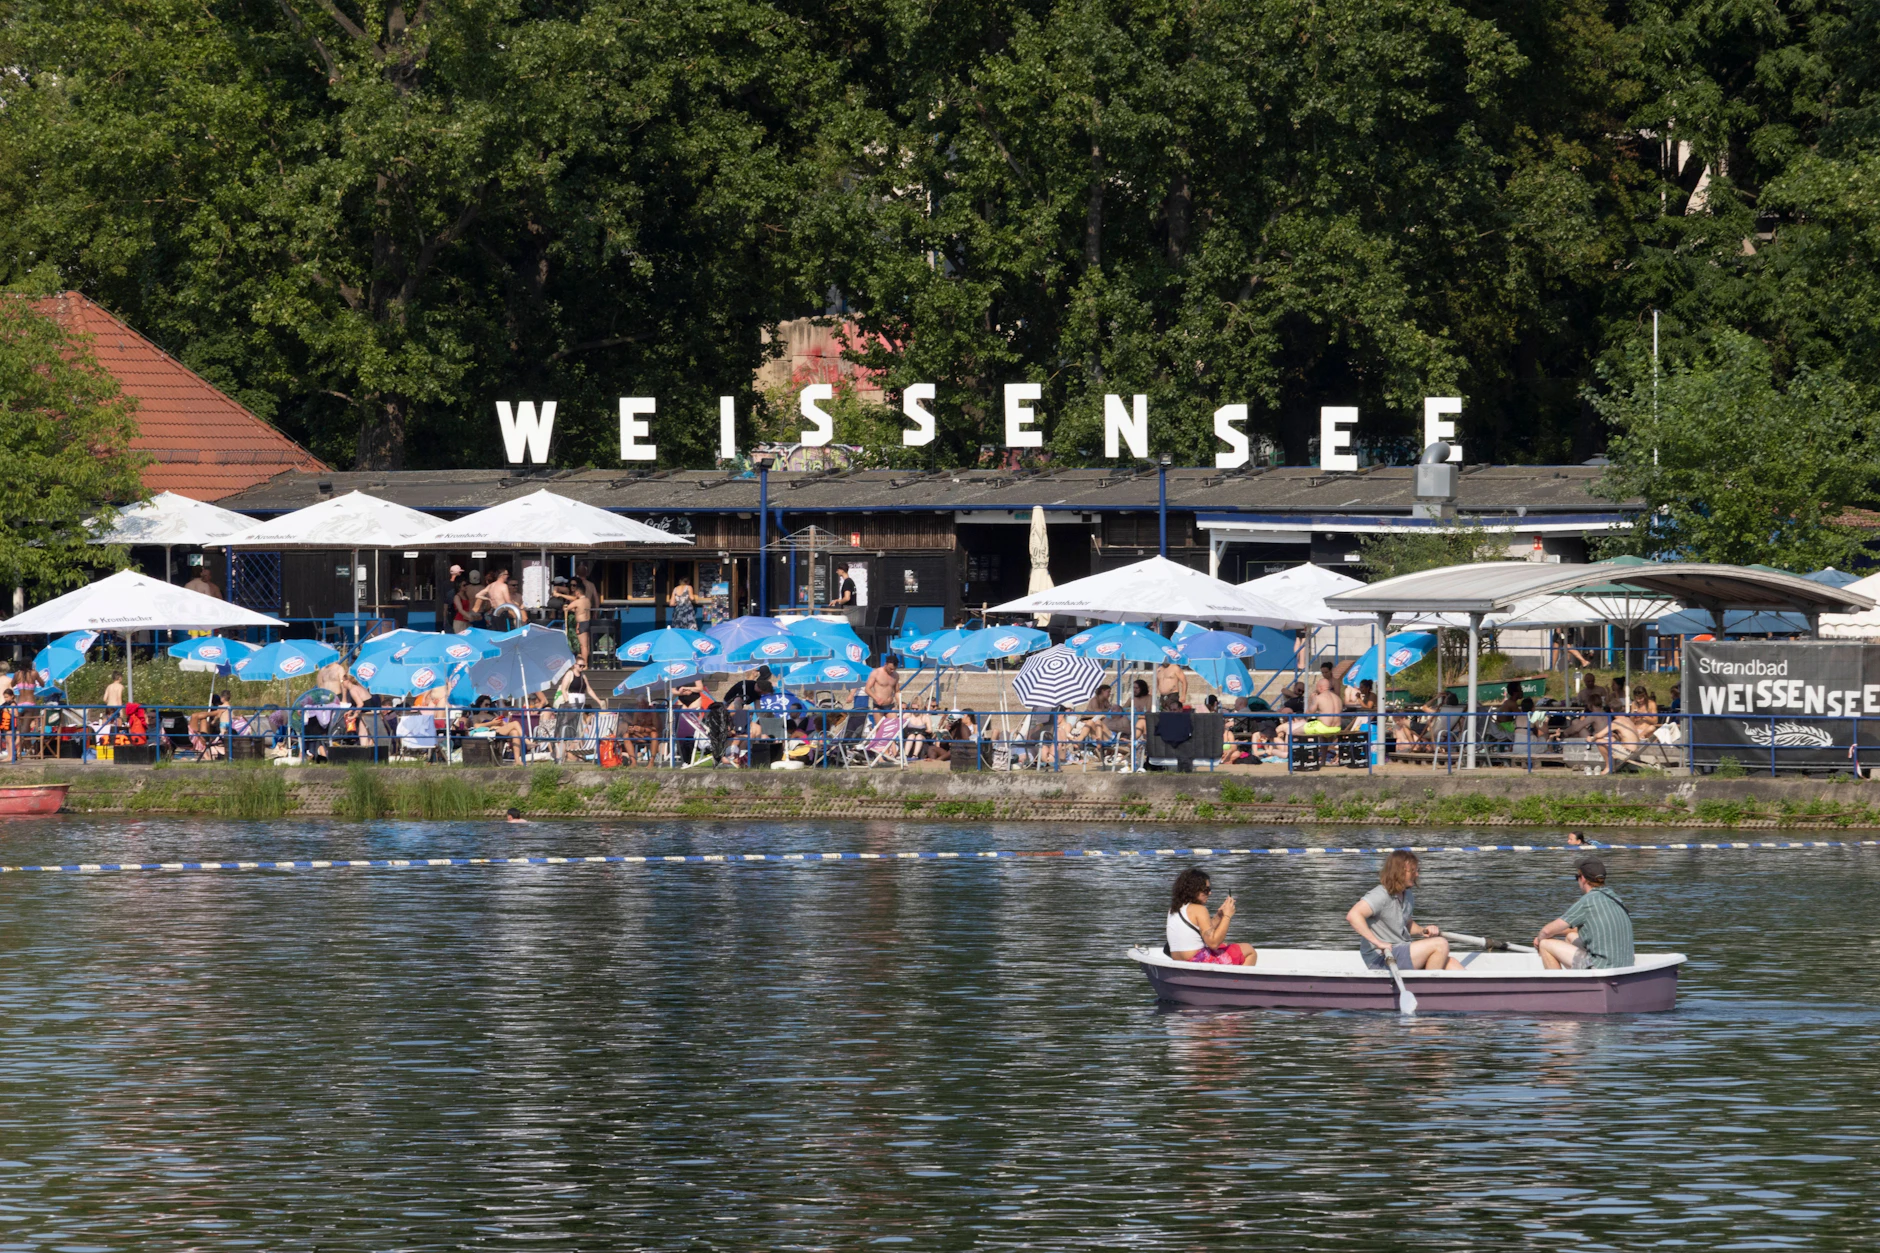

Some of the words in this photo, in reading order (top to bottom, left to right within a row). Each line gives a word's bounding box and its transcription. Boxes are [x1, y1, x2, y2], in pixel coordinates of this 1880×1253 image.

[495, 383, 1463, 472] WEISSENSEE
[99, 615, 153, 624] Krombacher
[1698, 657, 1788, 676] Strandbad
[1698, 679, 1880, 718] WEISSENSEE
